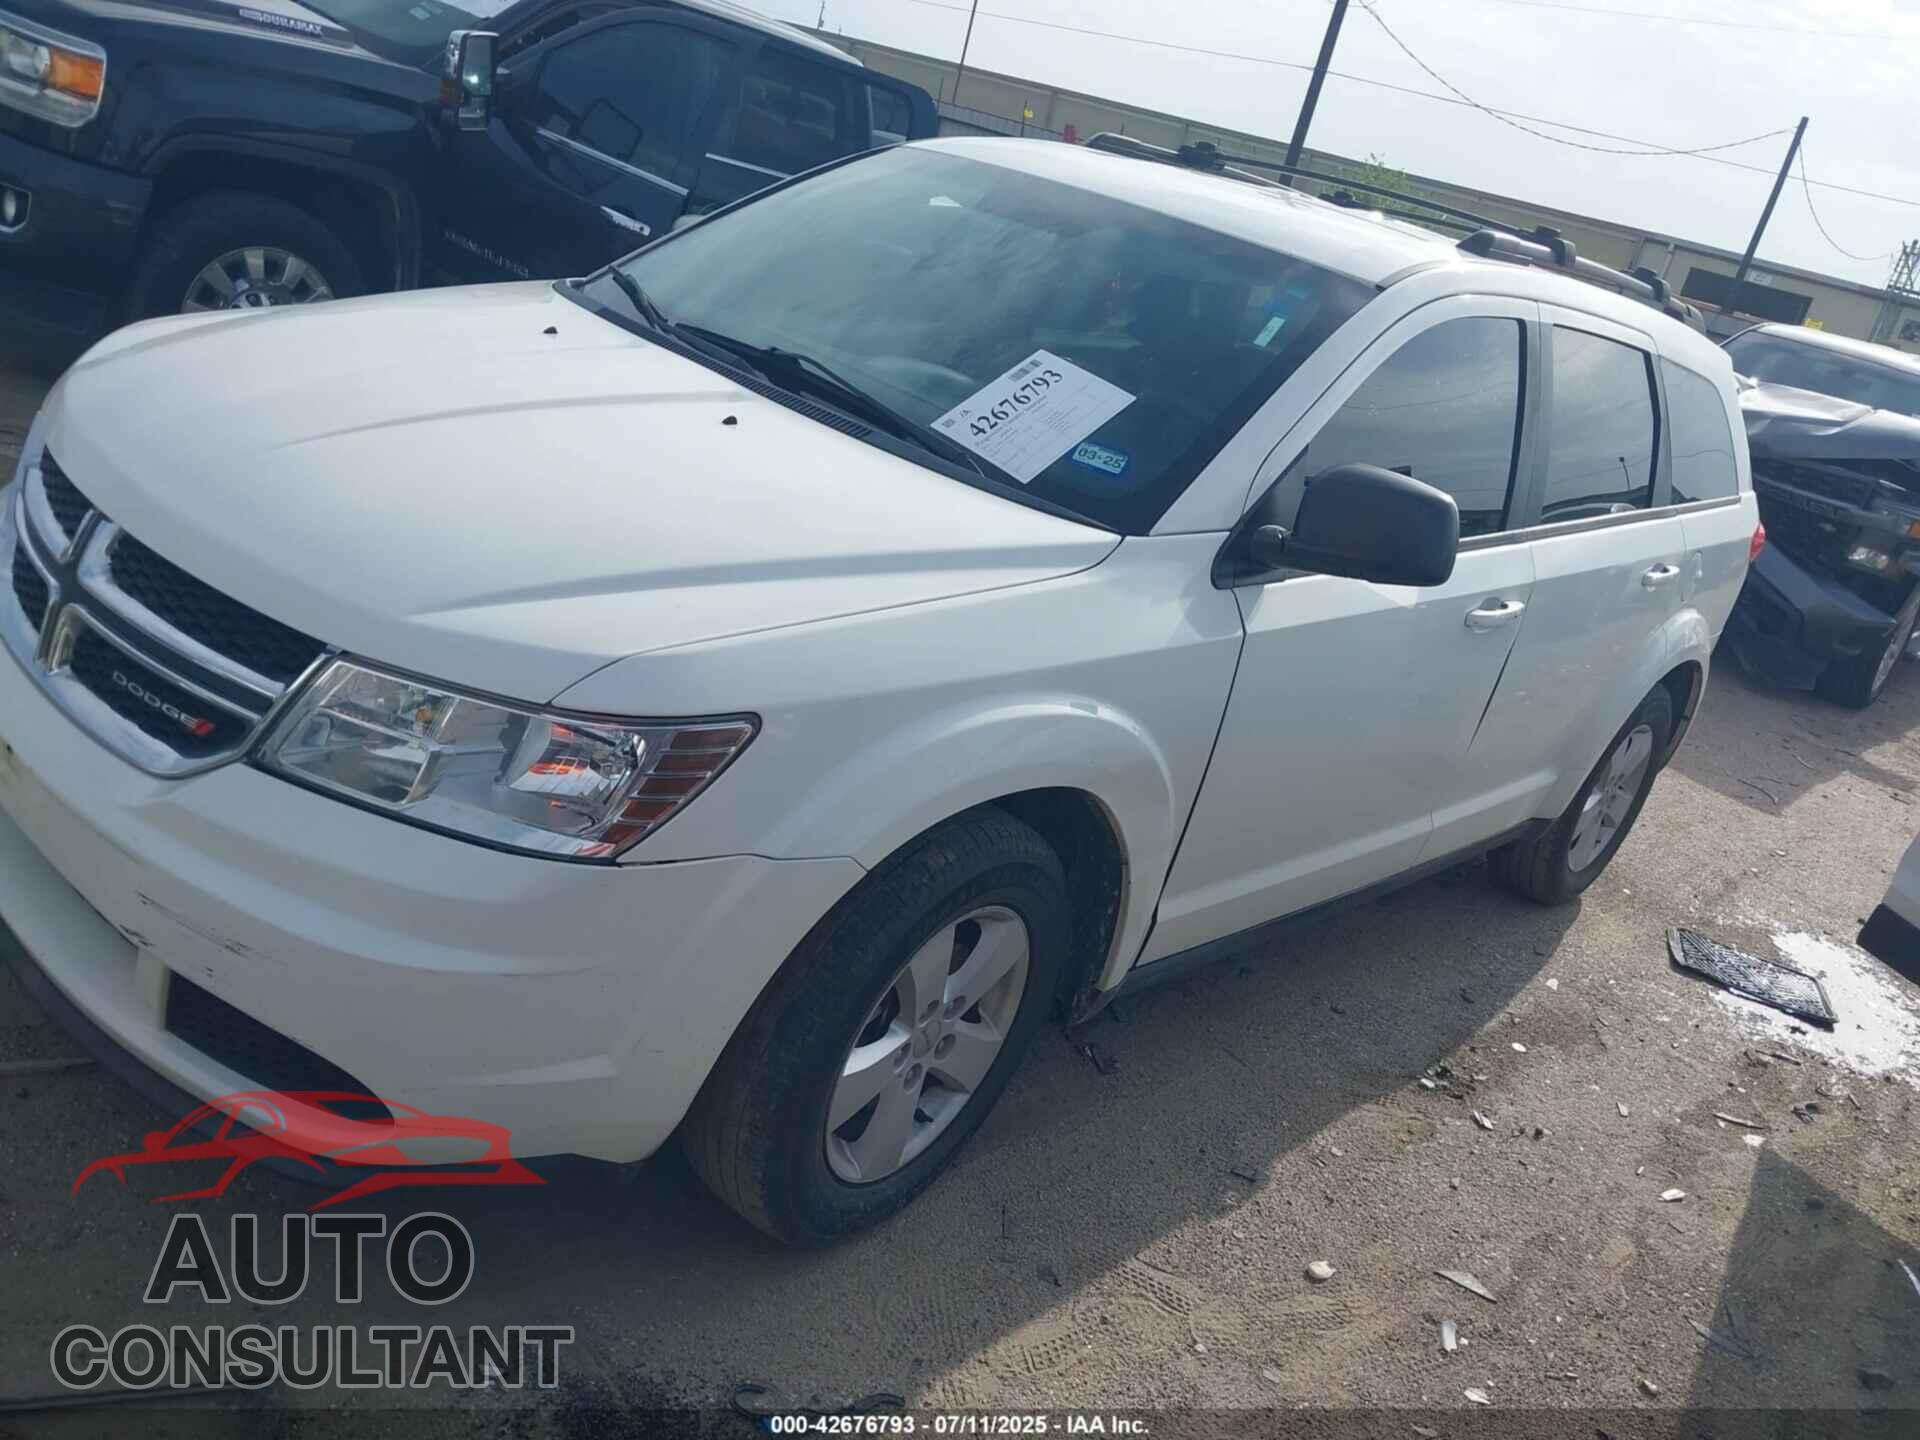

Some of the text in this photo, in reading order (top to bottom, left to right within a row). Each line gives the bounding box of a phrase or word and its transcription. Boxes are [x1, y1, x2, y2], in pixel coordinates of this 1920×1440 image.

[262, 13, 322, 34] DURAMAX
[969, 370, 1063, 437] 42676793
[112, 670, 198, 729] DODGE
